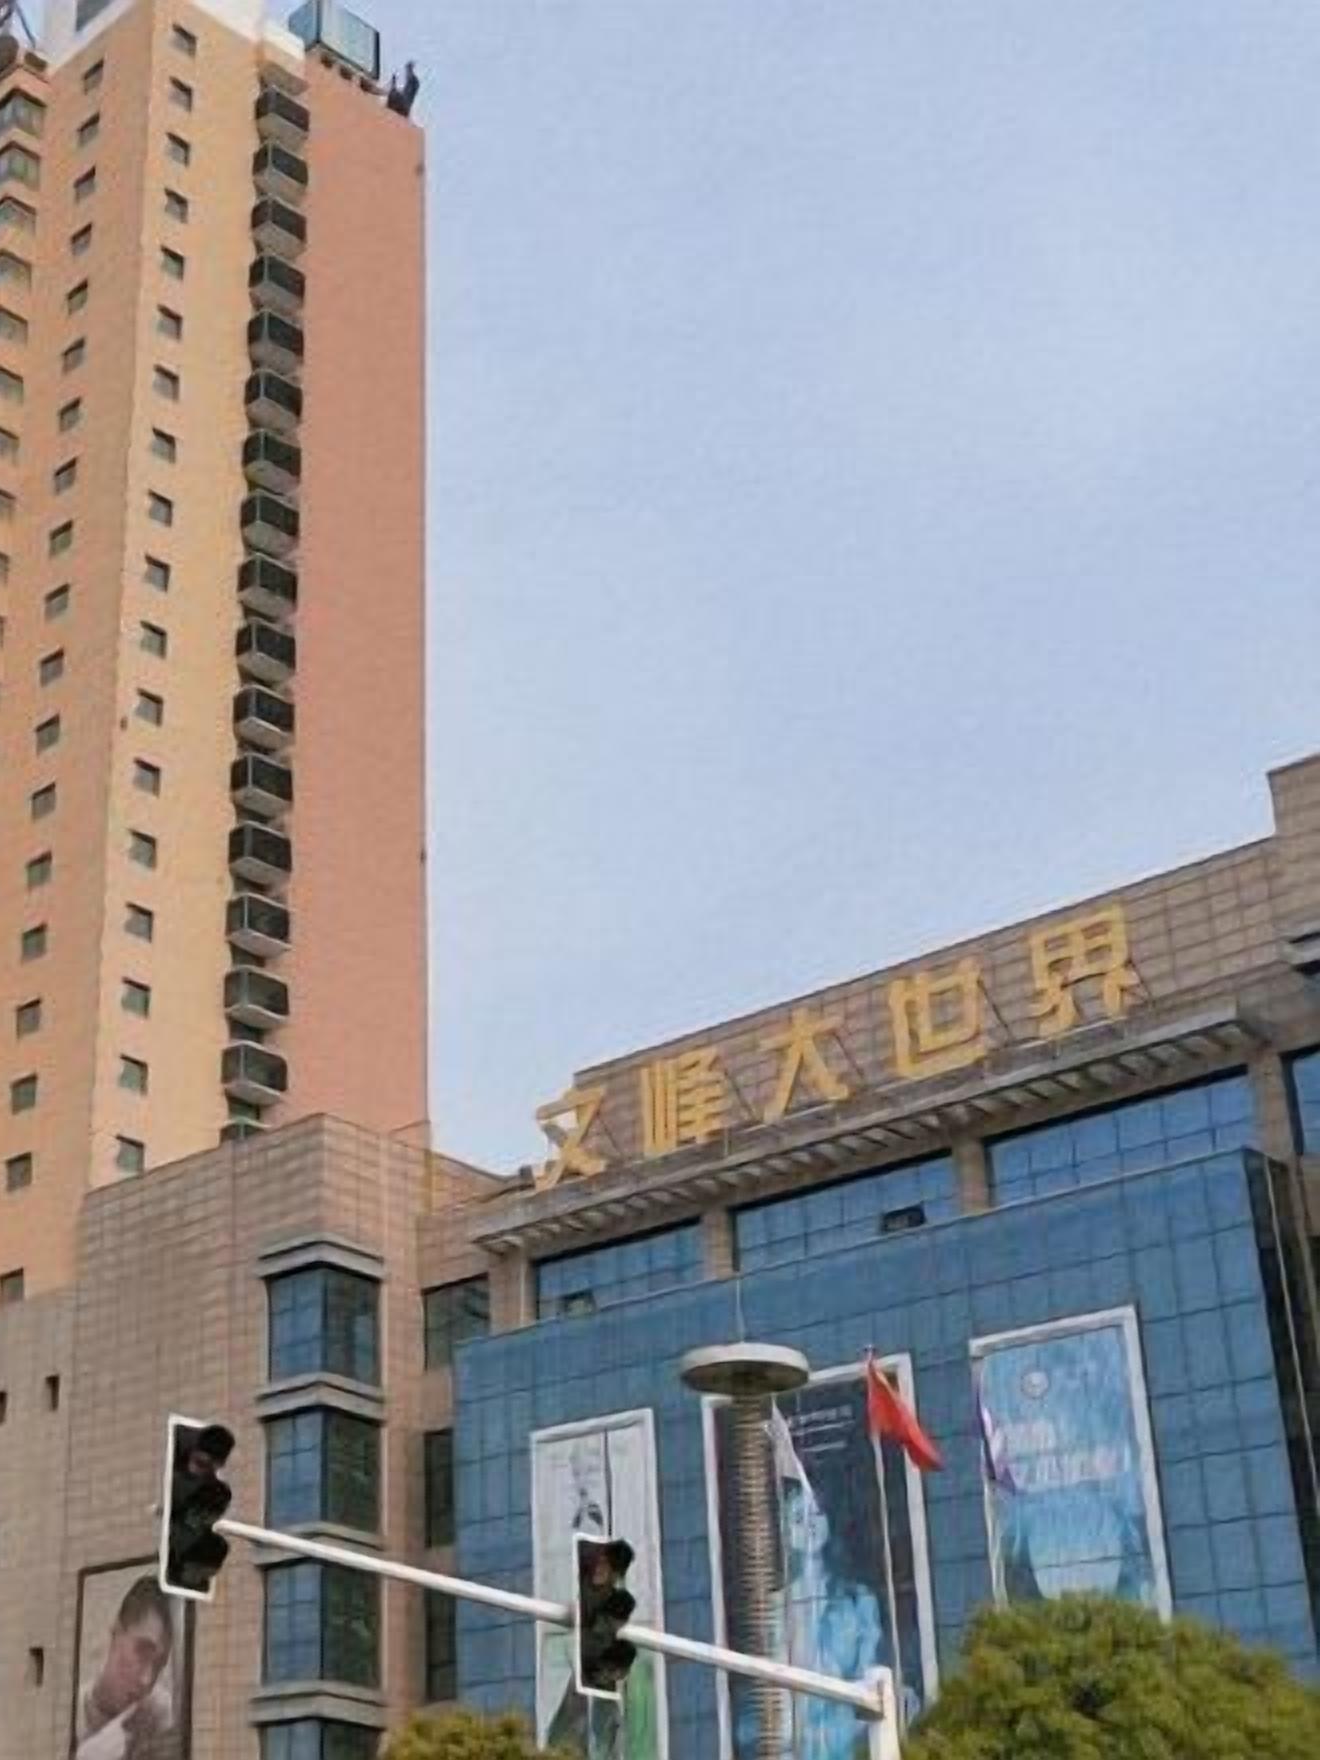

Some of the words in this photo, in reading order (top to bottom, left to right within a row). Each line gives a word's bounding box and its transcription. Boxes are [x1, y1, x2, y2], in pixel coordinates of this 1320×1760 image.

[535, 904, 1141, 1191] 文峰大世界
